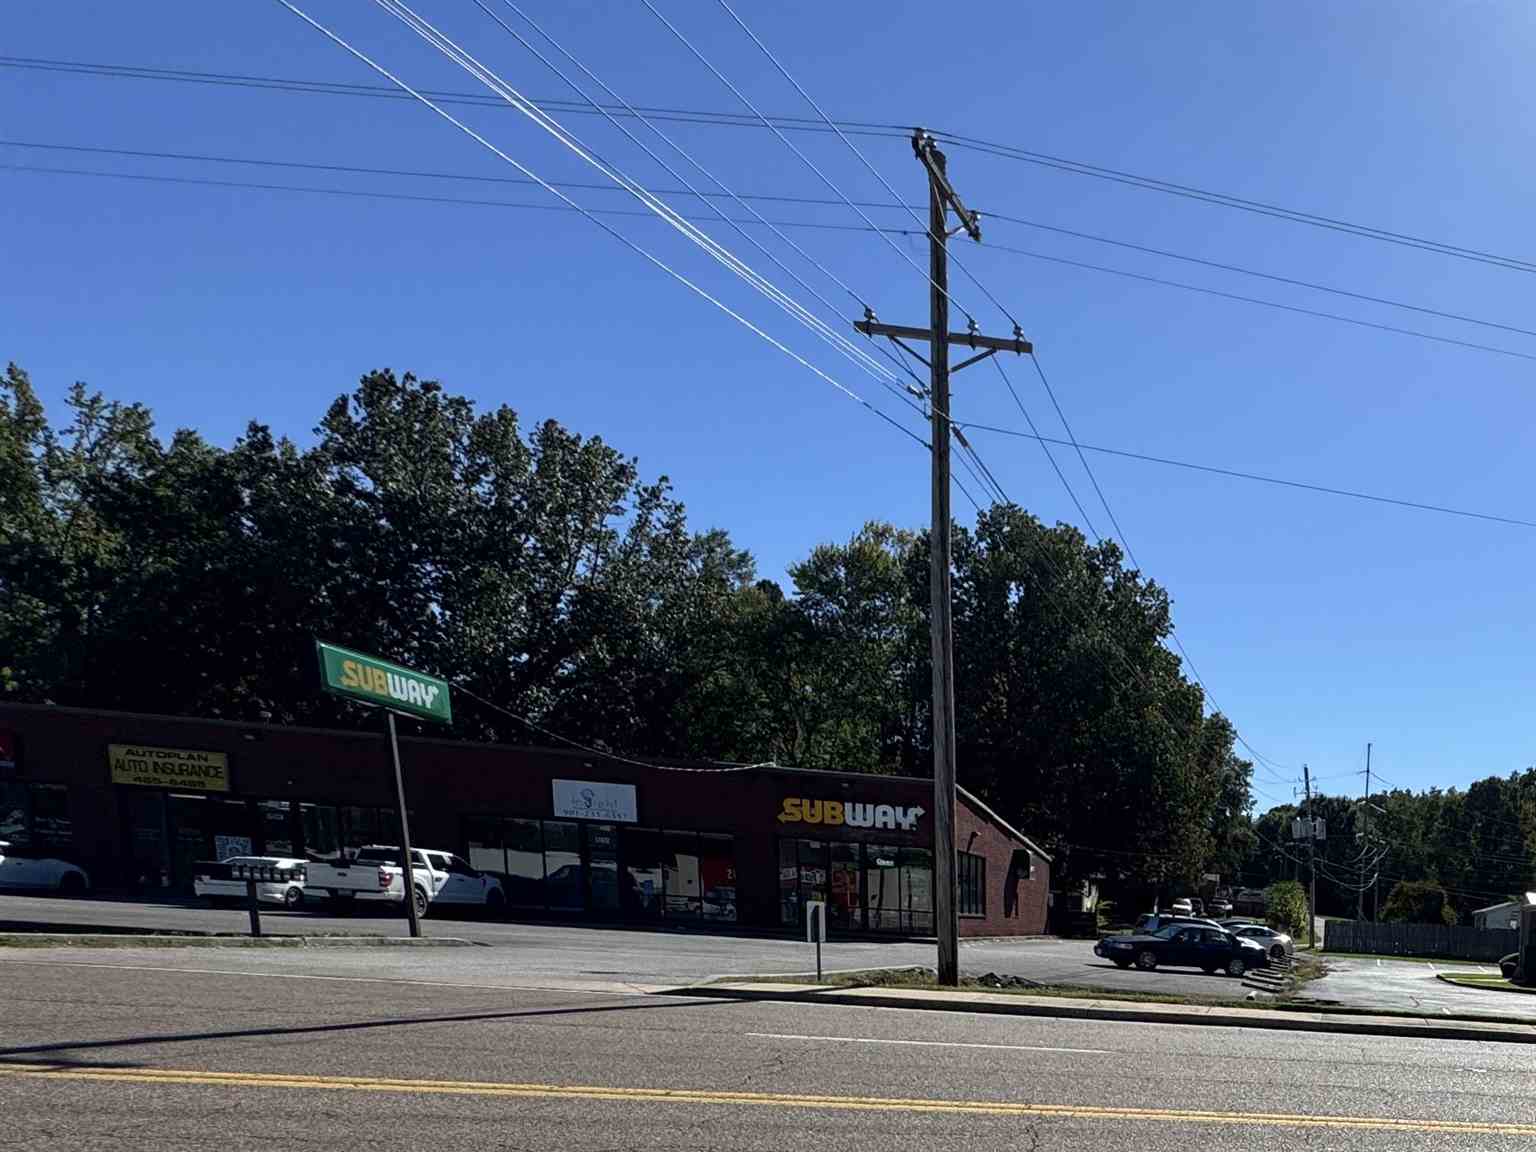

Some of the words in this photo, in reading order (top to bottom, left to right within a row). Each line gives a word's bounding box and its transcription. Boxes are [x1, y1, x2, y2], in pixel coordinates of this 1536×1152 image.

[339, 659, 440, 709] SUBWAY
[114, 758, 149, 773] AUTO
[152, 761, 225, 779] INSURANCE
[125, 748, 209, 763] AUTOPLAN
[777, 797, 926, 831] SUBWAY
